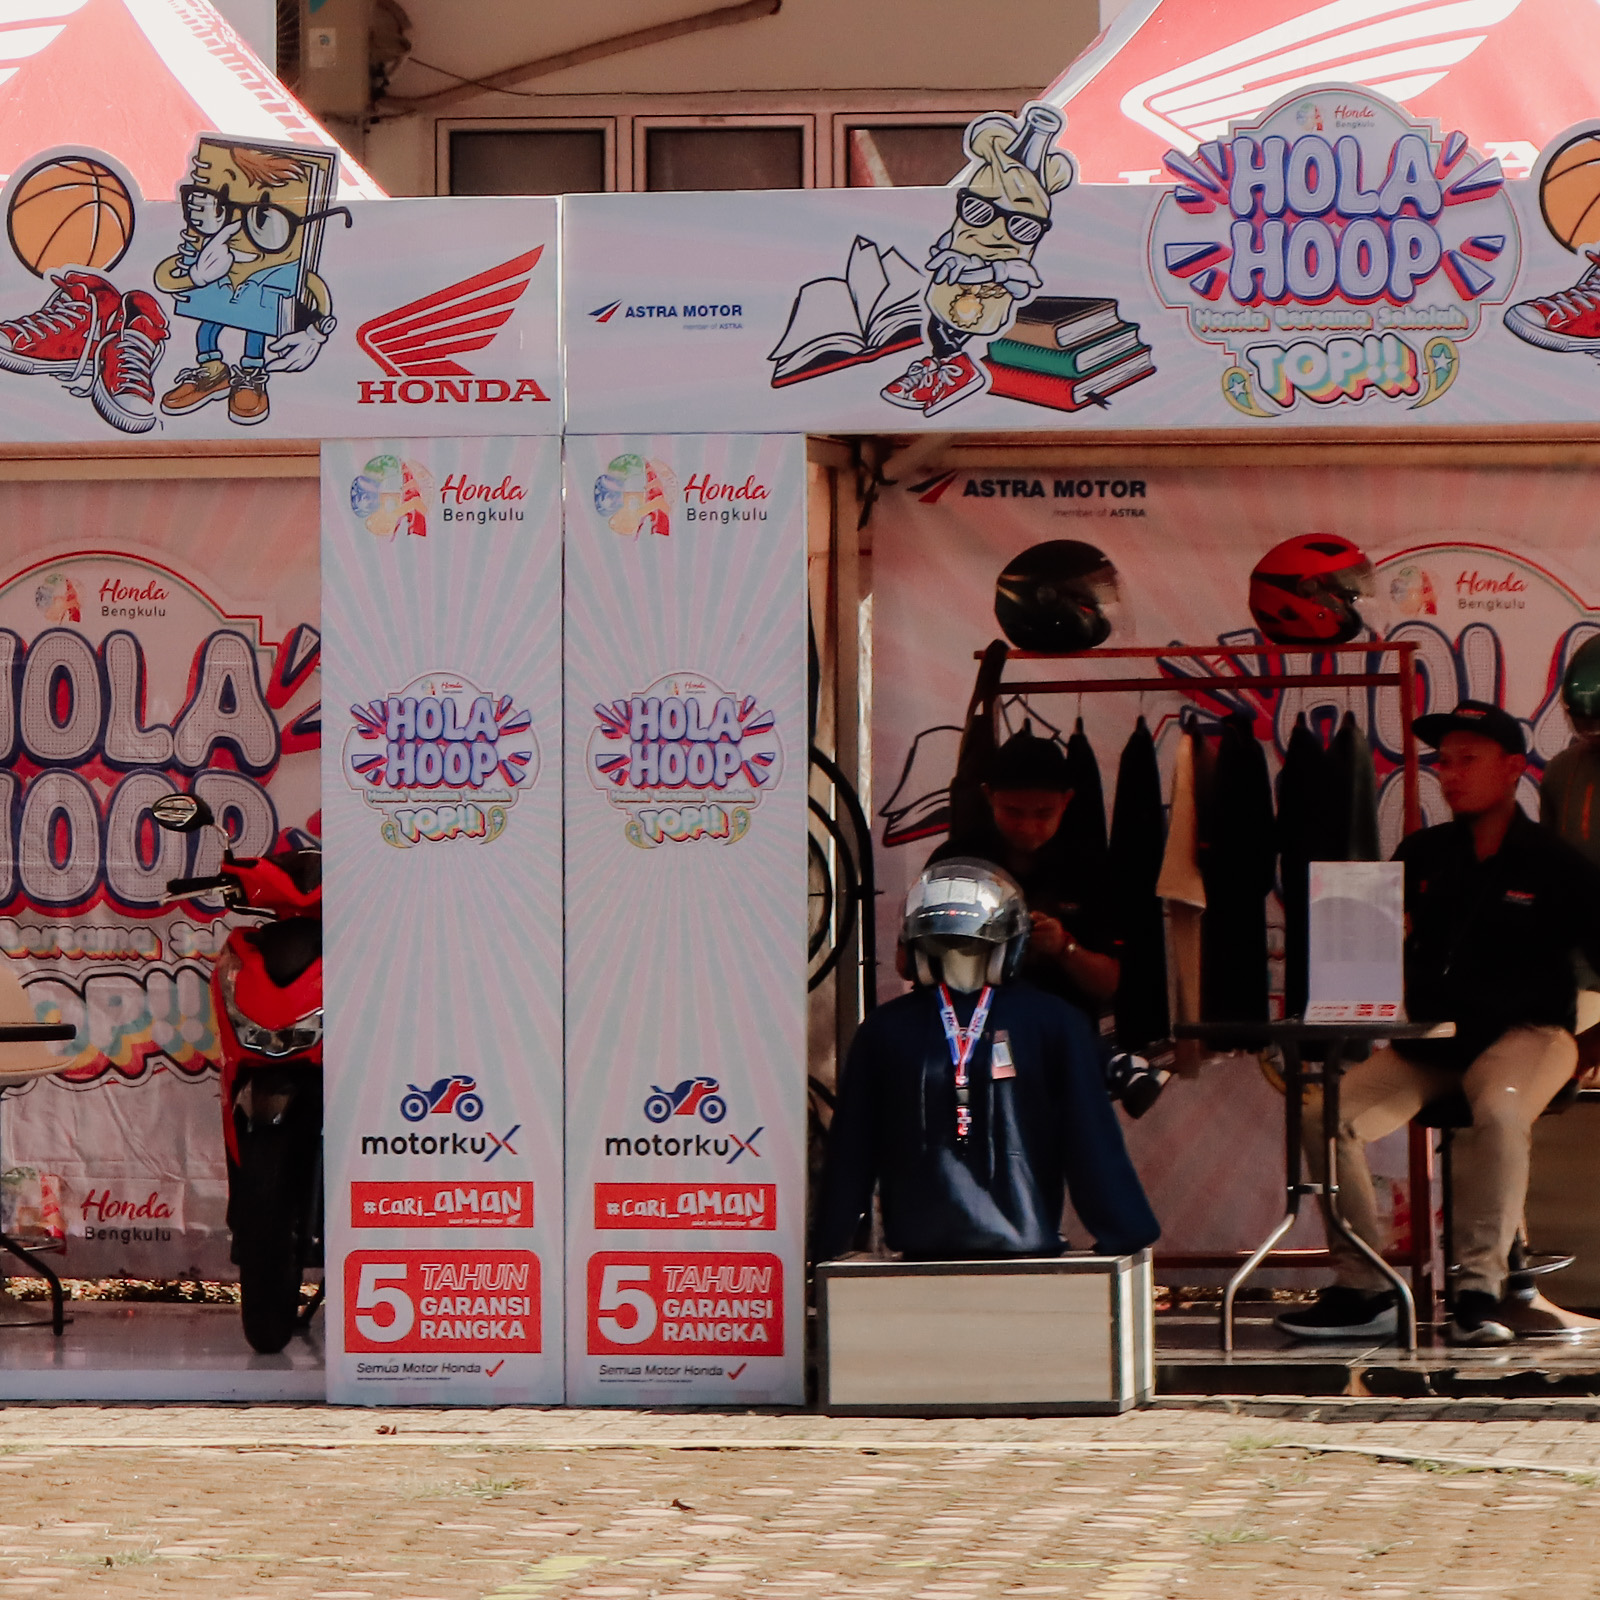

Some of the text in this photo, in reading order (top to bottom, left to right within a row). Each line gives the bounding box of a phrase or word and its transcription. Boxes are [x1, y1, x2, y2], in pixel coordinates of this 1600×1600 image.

[1334, 104, 1377, 119] Honda
[1335, 119, 1376, 129] Bengkulu
[1230, 135, 1443, 220] HOLA
[1229, 216, 1443, 305] HOOP
[625, 305, 743, 318] ASTRA MOTOR
[1195, 305, 1468, 332] Honda Bersama Sekolah
[1246, 332, 1419, 408] TOP!!
[357, 378, 551, 403] HONDA
[440, 473, 528, 505] Honda
[683, 473, 772, 505] Honda
[963, 480, 1146, 498] ASTRA MOTOR
[443, 507, 524, 523] Bengkulu
[686, 507, 768, 523] Bengkulu
[1053, 508, 1091, 518] member
[1110, 507, 1146, 518] ASTRA
[98, 577, 170, 604] Honda
[1456, 570, 1528, 595] Honda
[100, 604, 167, 619] Bengkulu
[1458, 597, 1526, 611] Bengkulu
[386, 697, 500, 743] HOLA
[630, 697, 744, 743] HOLA
[385, 741, 500, 789] HOOP
[629, 741, 743, 790] HOOP
[361, 1124, 522, 1162] motorkuX
[605, 1126, 765, 1164] motorkuX
[81, 1188, 174, 1221] Honda
[83, 1225, 171, 1244] Bengkulu
[420, 1263, 529, 1291] TAHUN
[662, 1265, 772, 1293] TAHUN
[355, 1263, 415, 1343] 5
[420, 1296, 531, 1316] GARANSI
[597, 1265, 658, 1345] 5
[662, 1298, 773, 1319] GARANSI
[420, 1319, 526, 1340] RANGKA
[662, 1322, 768, 1342] RANGKA
[357, 1362, 481, 1374] Semua Motor Honda
[599, 1364, 723, 1376] Semua Motor Honda
